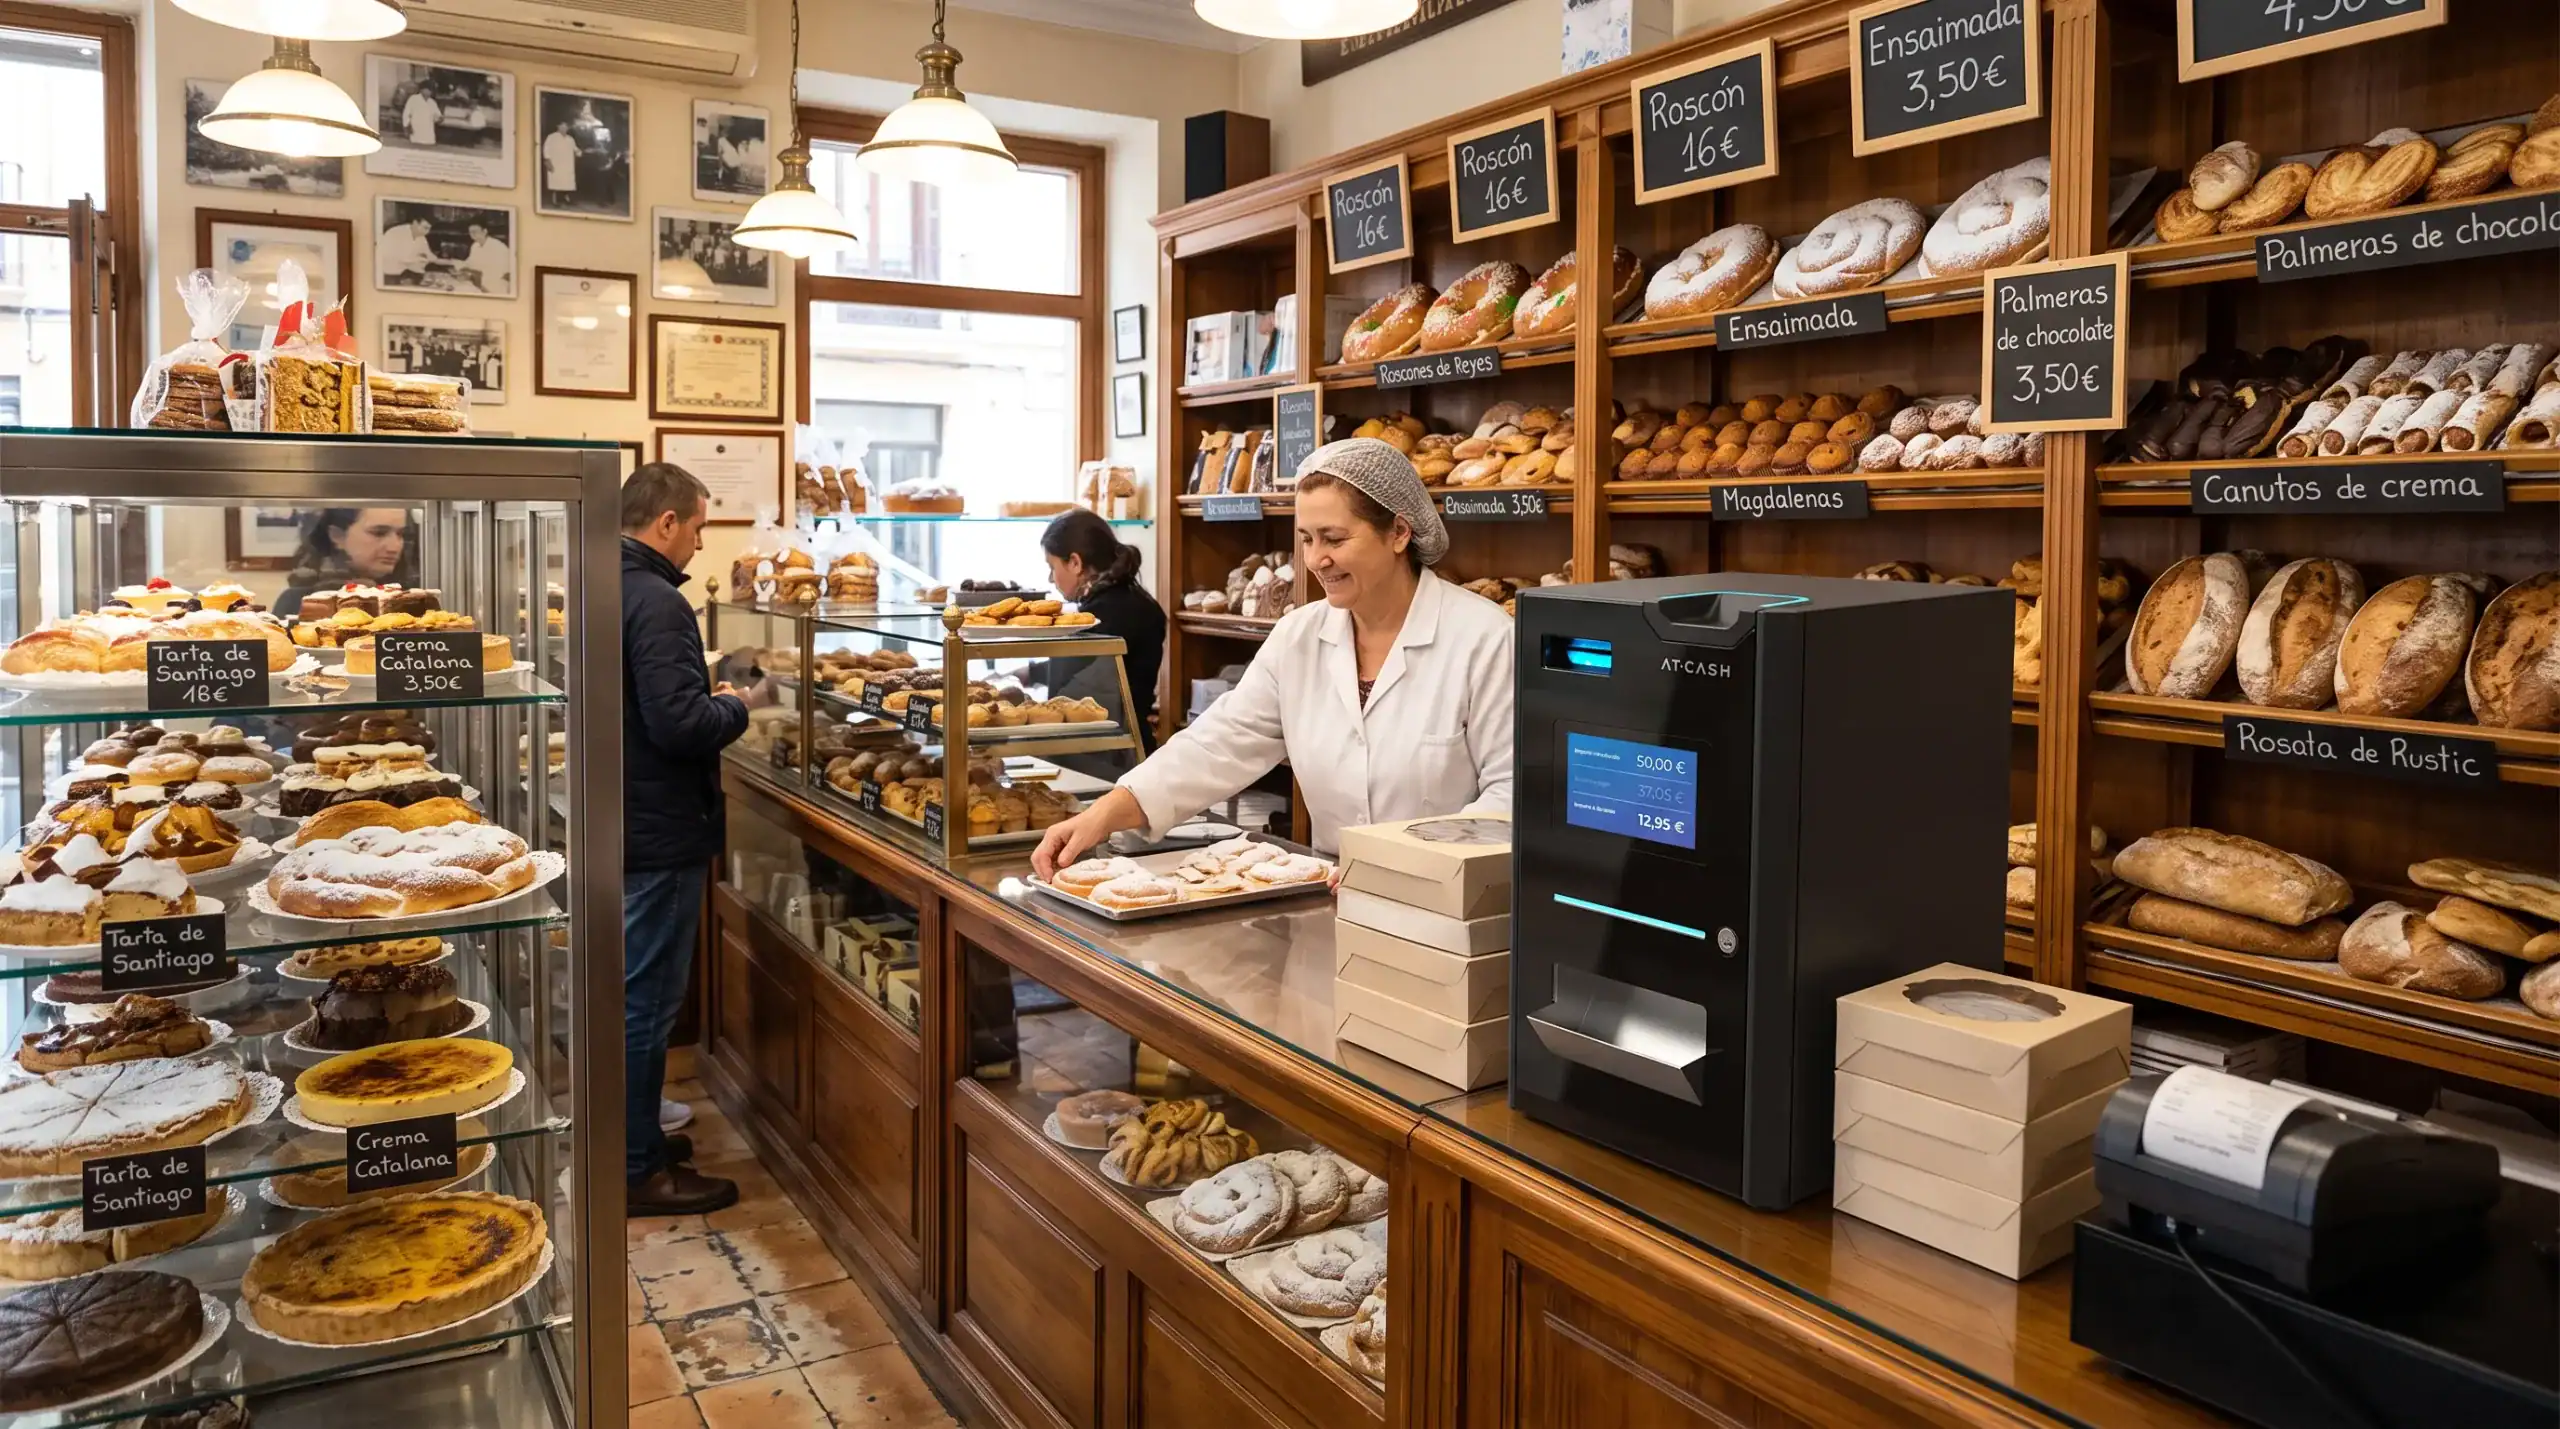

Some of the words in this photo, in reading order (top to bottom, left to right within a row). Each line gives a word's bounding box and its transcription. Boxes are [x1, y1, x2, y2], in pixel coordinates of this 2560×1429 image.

[1870, 0, 2022, 66] Ensaimada
[1902, 55, 2007, 113] 3,50€
[1651, 76, 1745, 131] Roscón
[1462, 135, 1532, 177] Roscón
[1682, 126, 1741, 174] 16€
[1335, 181, 1393, 216] Roscón
[1484, 176, 1528, 214] 16€
[1356, 216, 1389, 249] 16€
[2264, 236, 2398, 272] Palmeras
[2411, 220, 2444, 249] de
[1999, 284, 2108, 314] Palmeras
[1729, 303, 1858, 341] Ensaimada
[1996, 327, 2020, 351] de
[2026, 317, 2114, 348] chocolate
[1380, 361, 1433, 384] Roscones
[1436, 357, 1452, 377] de
[1453, 355, 1493, 379] Reyes
[2012, 362, 2100, 405] 3,50€
[1720, 483, 1844, 518] Magdalenas
[2203, 472, 2322, 504] Canutos
[2336, 472, 2367, 500] de
[2381, 477, 2484, 499] crema
[1511, 493, 1544, 517] 3,50€
[151, 643, 214, 662] Tarta
[224, 643, 251, 661] de
[381, 636, 450, 652] Crema
[155, 664, 256, 688] Santiago
[380, 654, 474, 671] Catalana
[404, 674, 463, 693] 3,50€
[1636, 754, 1673, 772] 50,00
[1675, 761, 1687, 775] €
[2236, 722, 2337, 758] Rosata
[2350, 736, 2379, 764] de
[2390, 738, 2482, 777] Rustic
[1637, 813, 1671, 831] 12,95
[1674, 821, 1685, 834] €
[105, 927, 168, 948] Tarta
[179, 923, 205, 942] de
[112, 949, 215, 976] Santiago
[356, 1132, 430, 1151] Crema
[87, 1163, 152, 1185] Tarta
[162, 1156, 189, 1176] de
[355, 1153, 452, 1178] Catalana
[92, 1186, 193, 1213] Santiago
